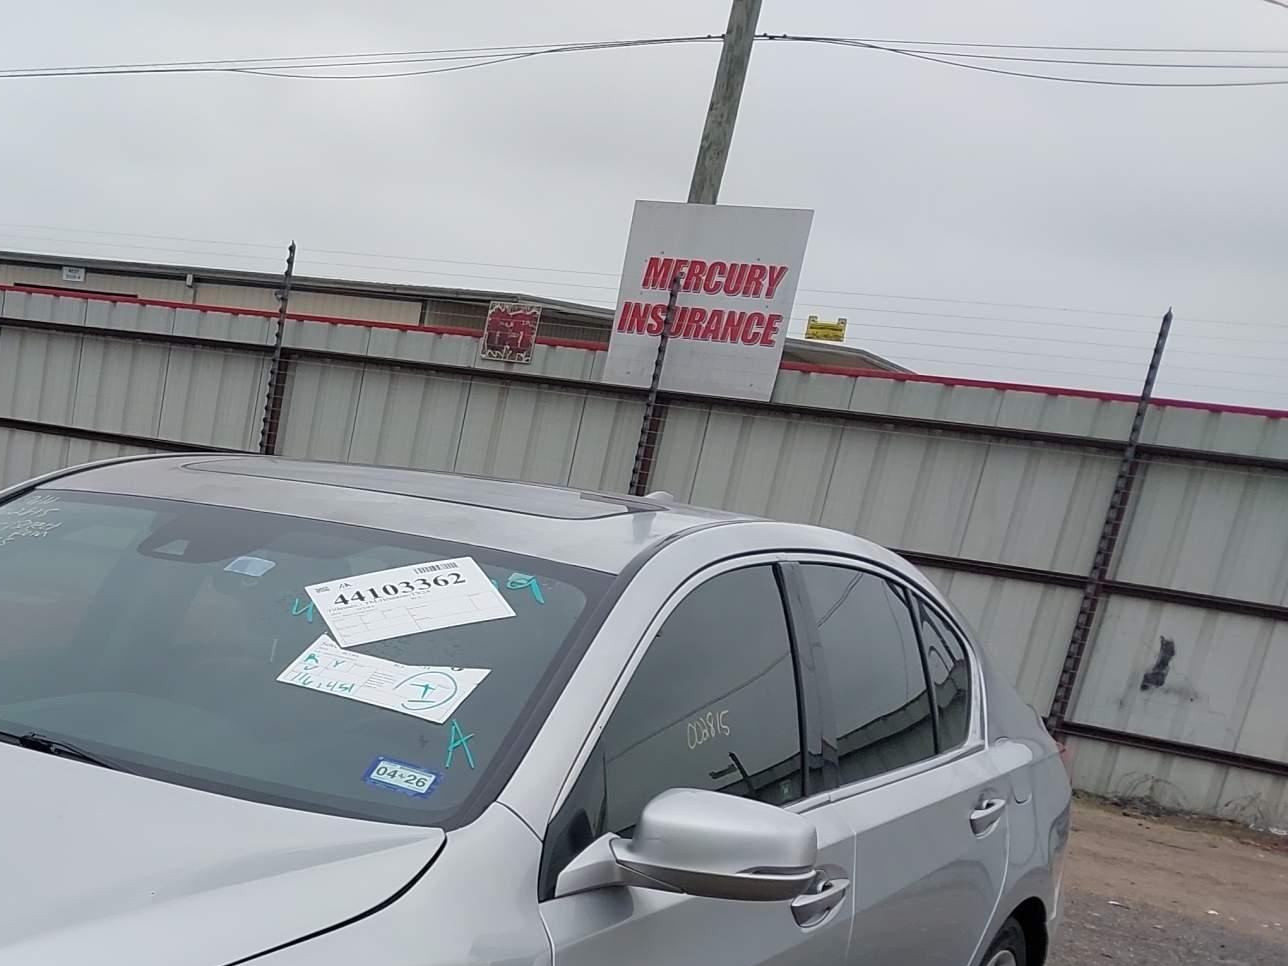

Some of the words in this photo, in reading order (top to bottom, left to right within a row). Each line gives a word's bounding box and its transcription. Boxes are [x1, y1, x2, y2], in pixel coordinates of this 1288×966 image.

[642, 257, 788, 299] MERCURY
[617, 301, 783, 347] INSURANCE
[333, 572, 466, 606] 44103362
